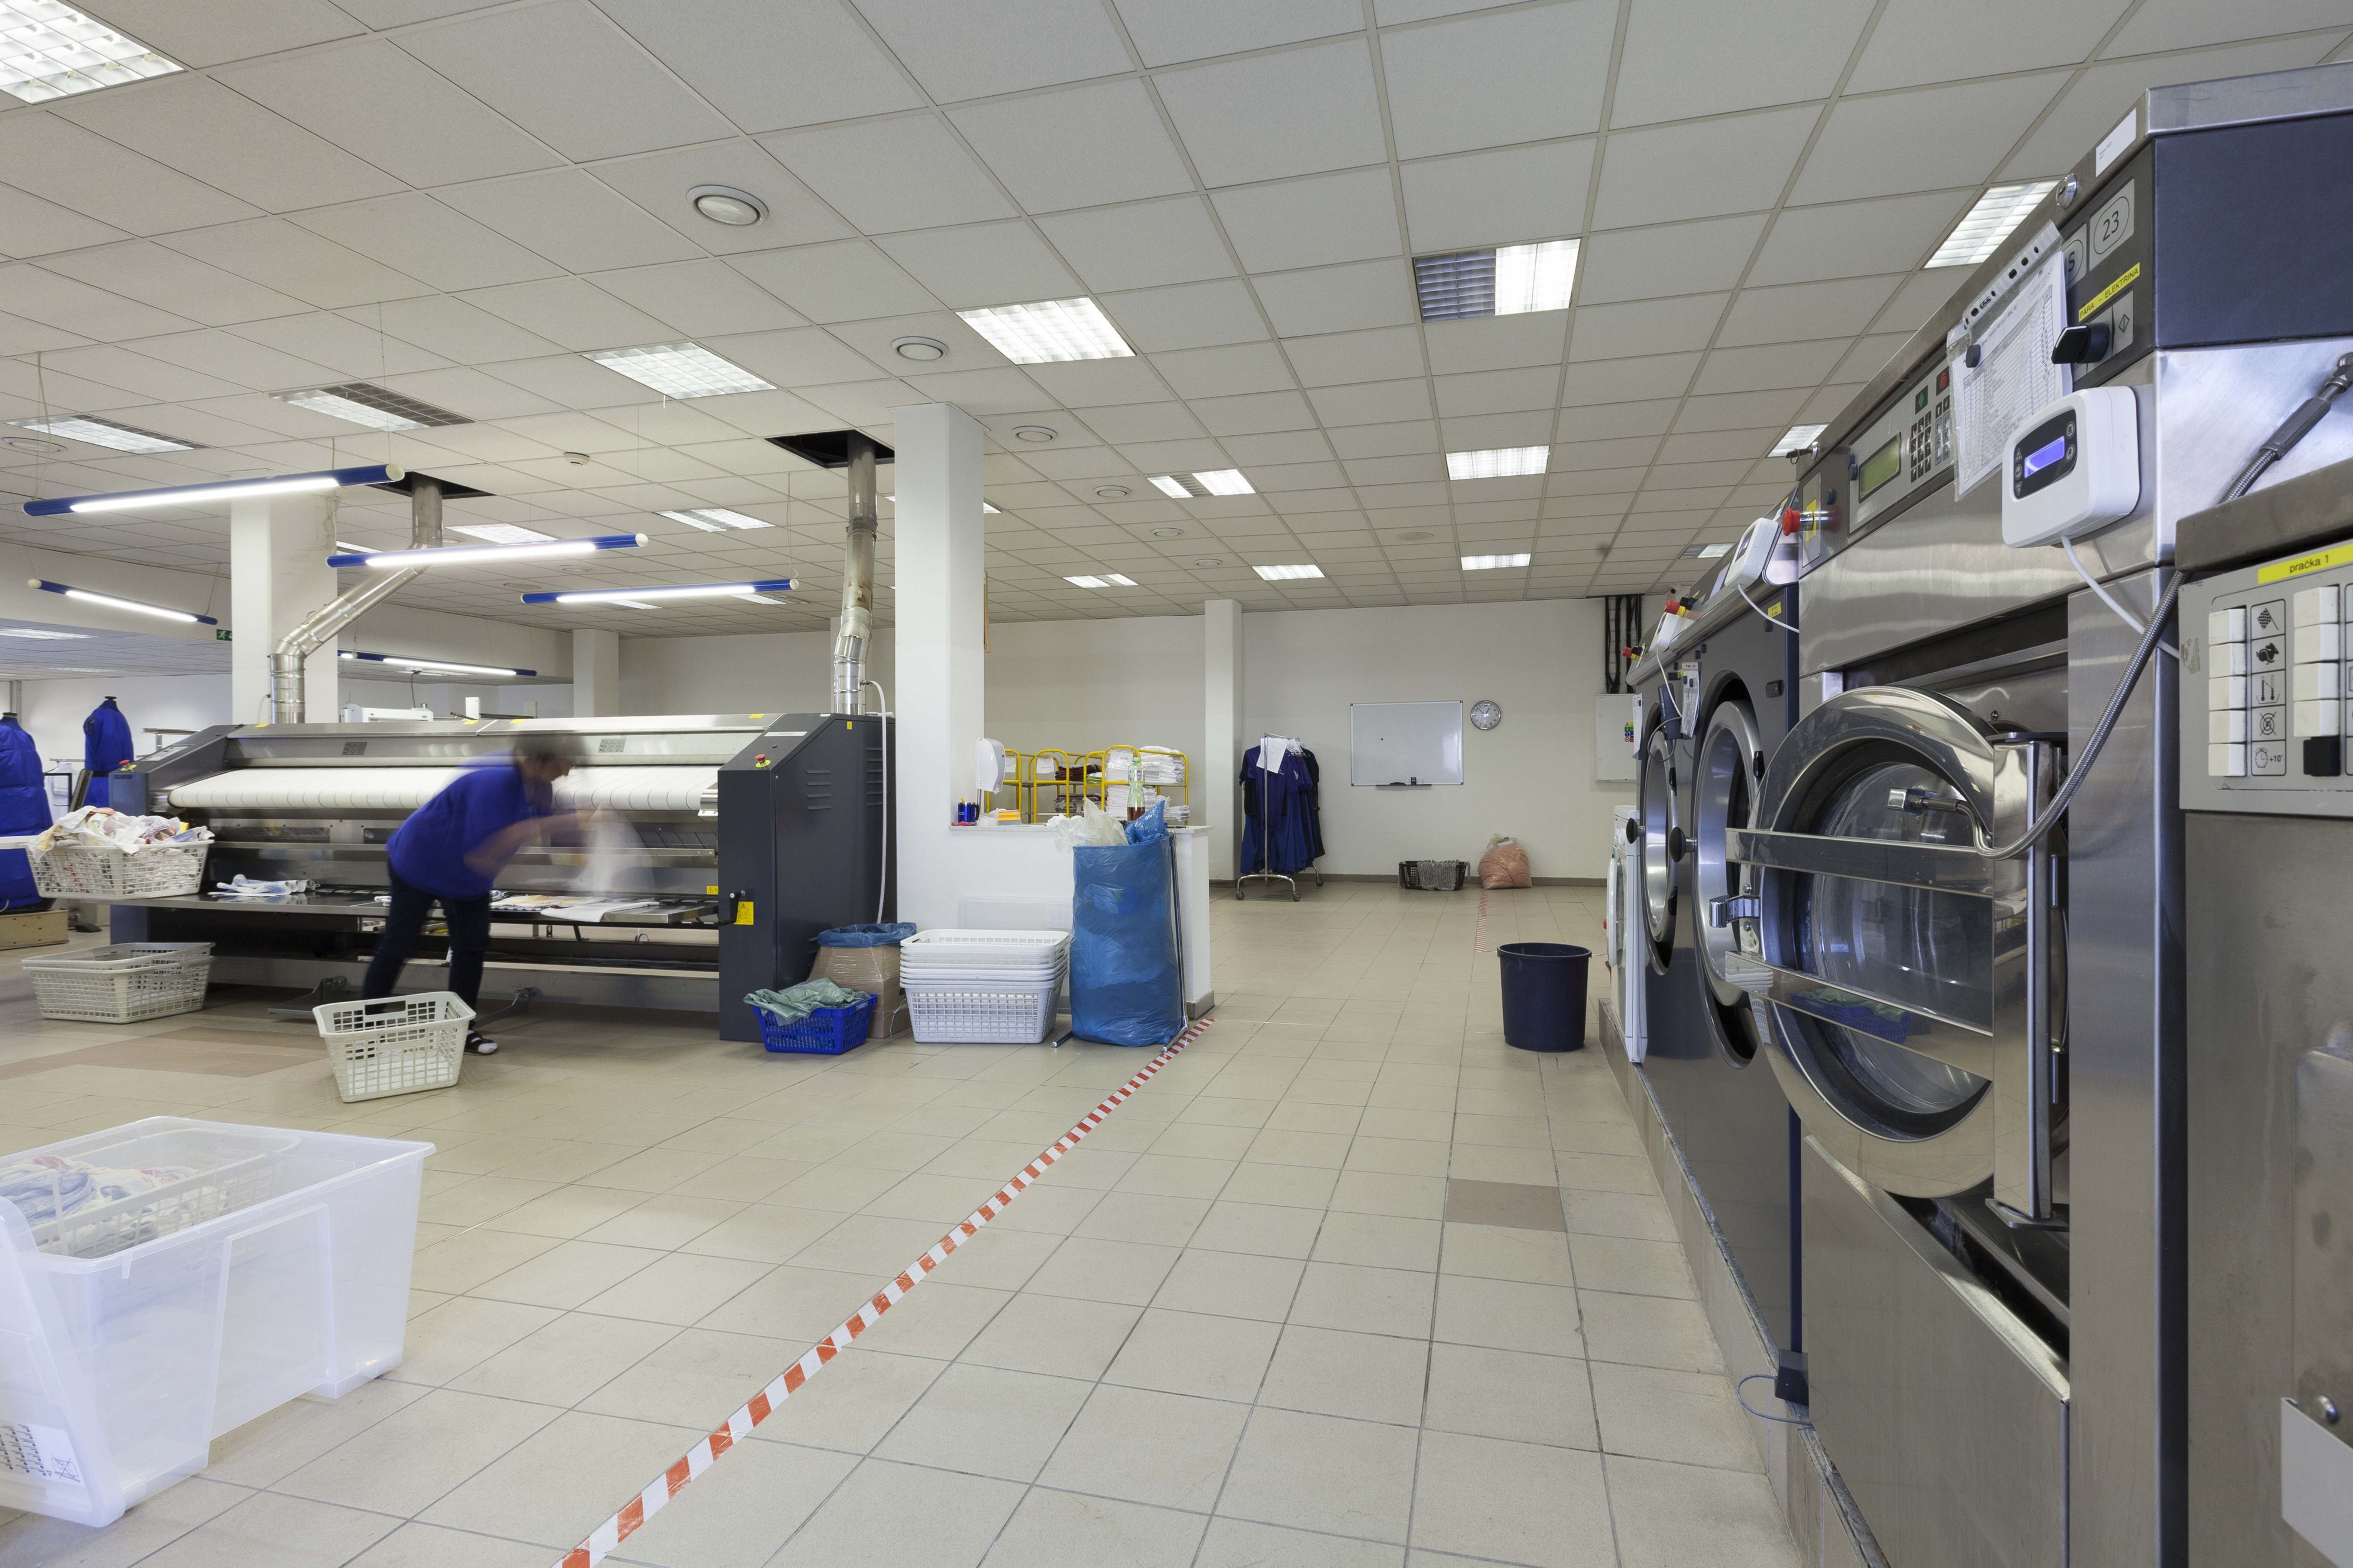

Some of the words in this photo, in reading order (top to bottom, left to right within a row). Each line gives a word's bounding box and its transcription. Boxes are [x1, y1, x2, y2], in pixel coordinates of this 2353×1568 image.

[2102, 211, 2119, 242] 23
[2079, 302, 2094, 319] PARA
[2105, 268, 2138, 298] ELEKTRINA
[2289, 558, 2321, 574] pračka
[2325, 554, 2329, 563] 1
